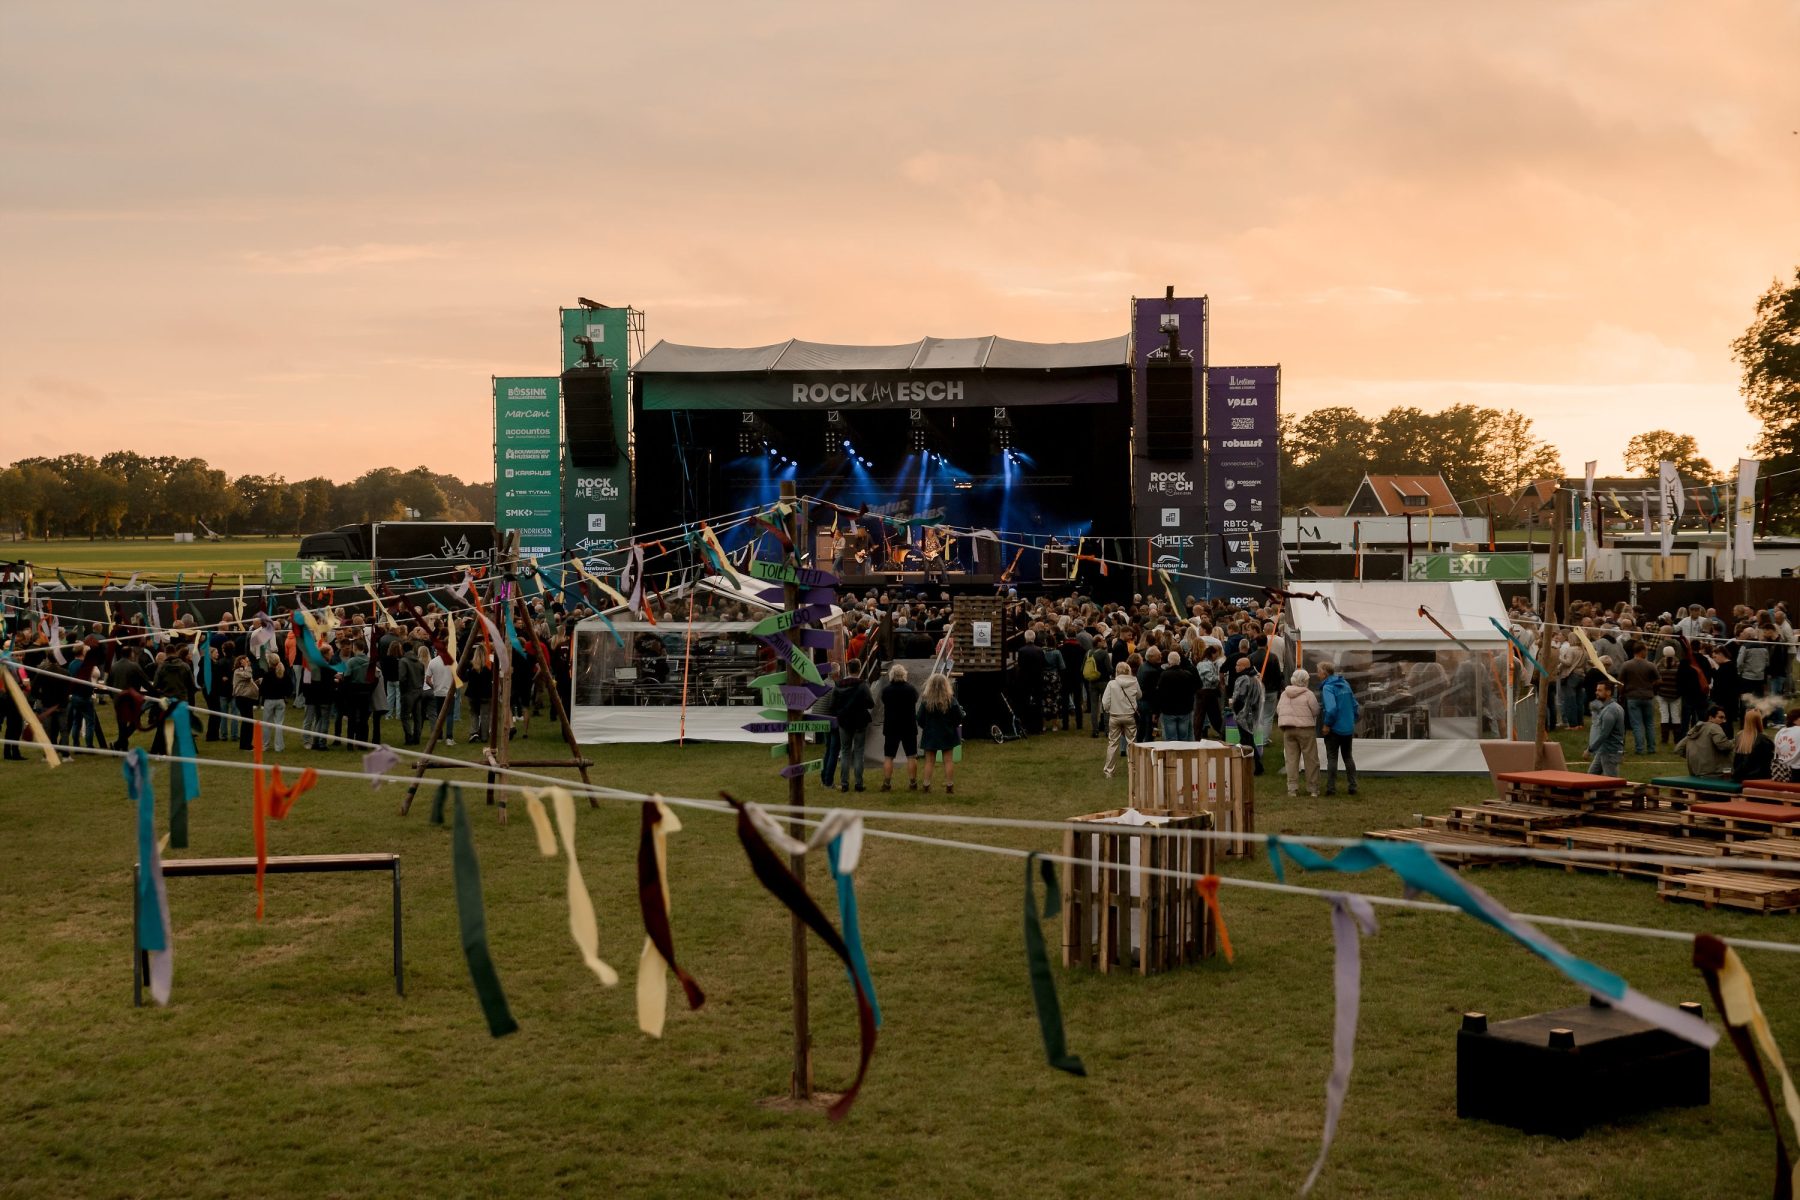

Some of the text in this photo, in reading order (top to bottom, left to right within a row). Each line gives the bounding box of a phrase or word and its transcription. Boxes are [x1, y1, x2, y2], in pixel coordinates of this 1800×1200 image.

[792, 381, 964, 403] ROCK AM ESCH
[505, 409, 551, 418] MarCant
[505, 428, 551, 436] accountos
[1222, 439, 1263, 448] robuust
[1150, 472, 1186, 482] ROCK
[577, 478, 612, 488] ROCK
[505, 509, 524, 517] SMK
[1223, 520, 1249, 528] RBTC
[1449, 557, 1491, 574] EXIT
[301, 564, 338, 581] EXIT
[777, 608, 810, 630] EHBO
